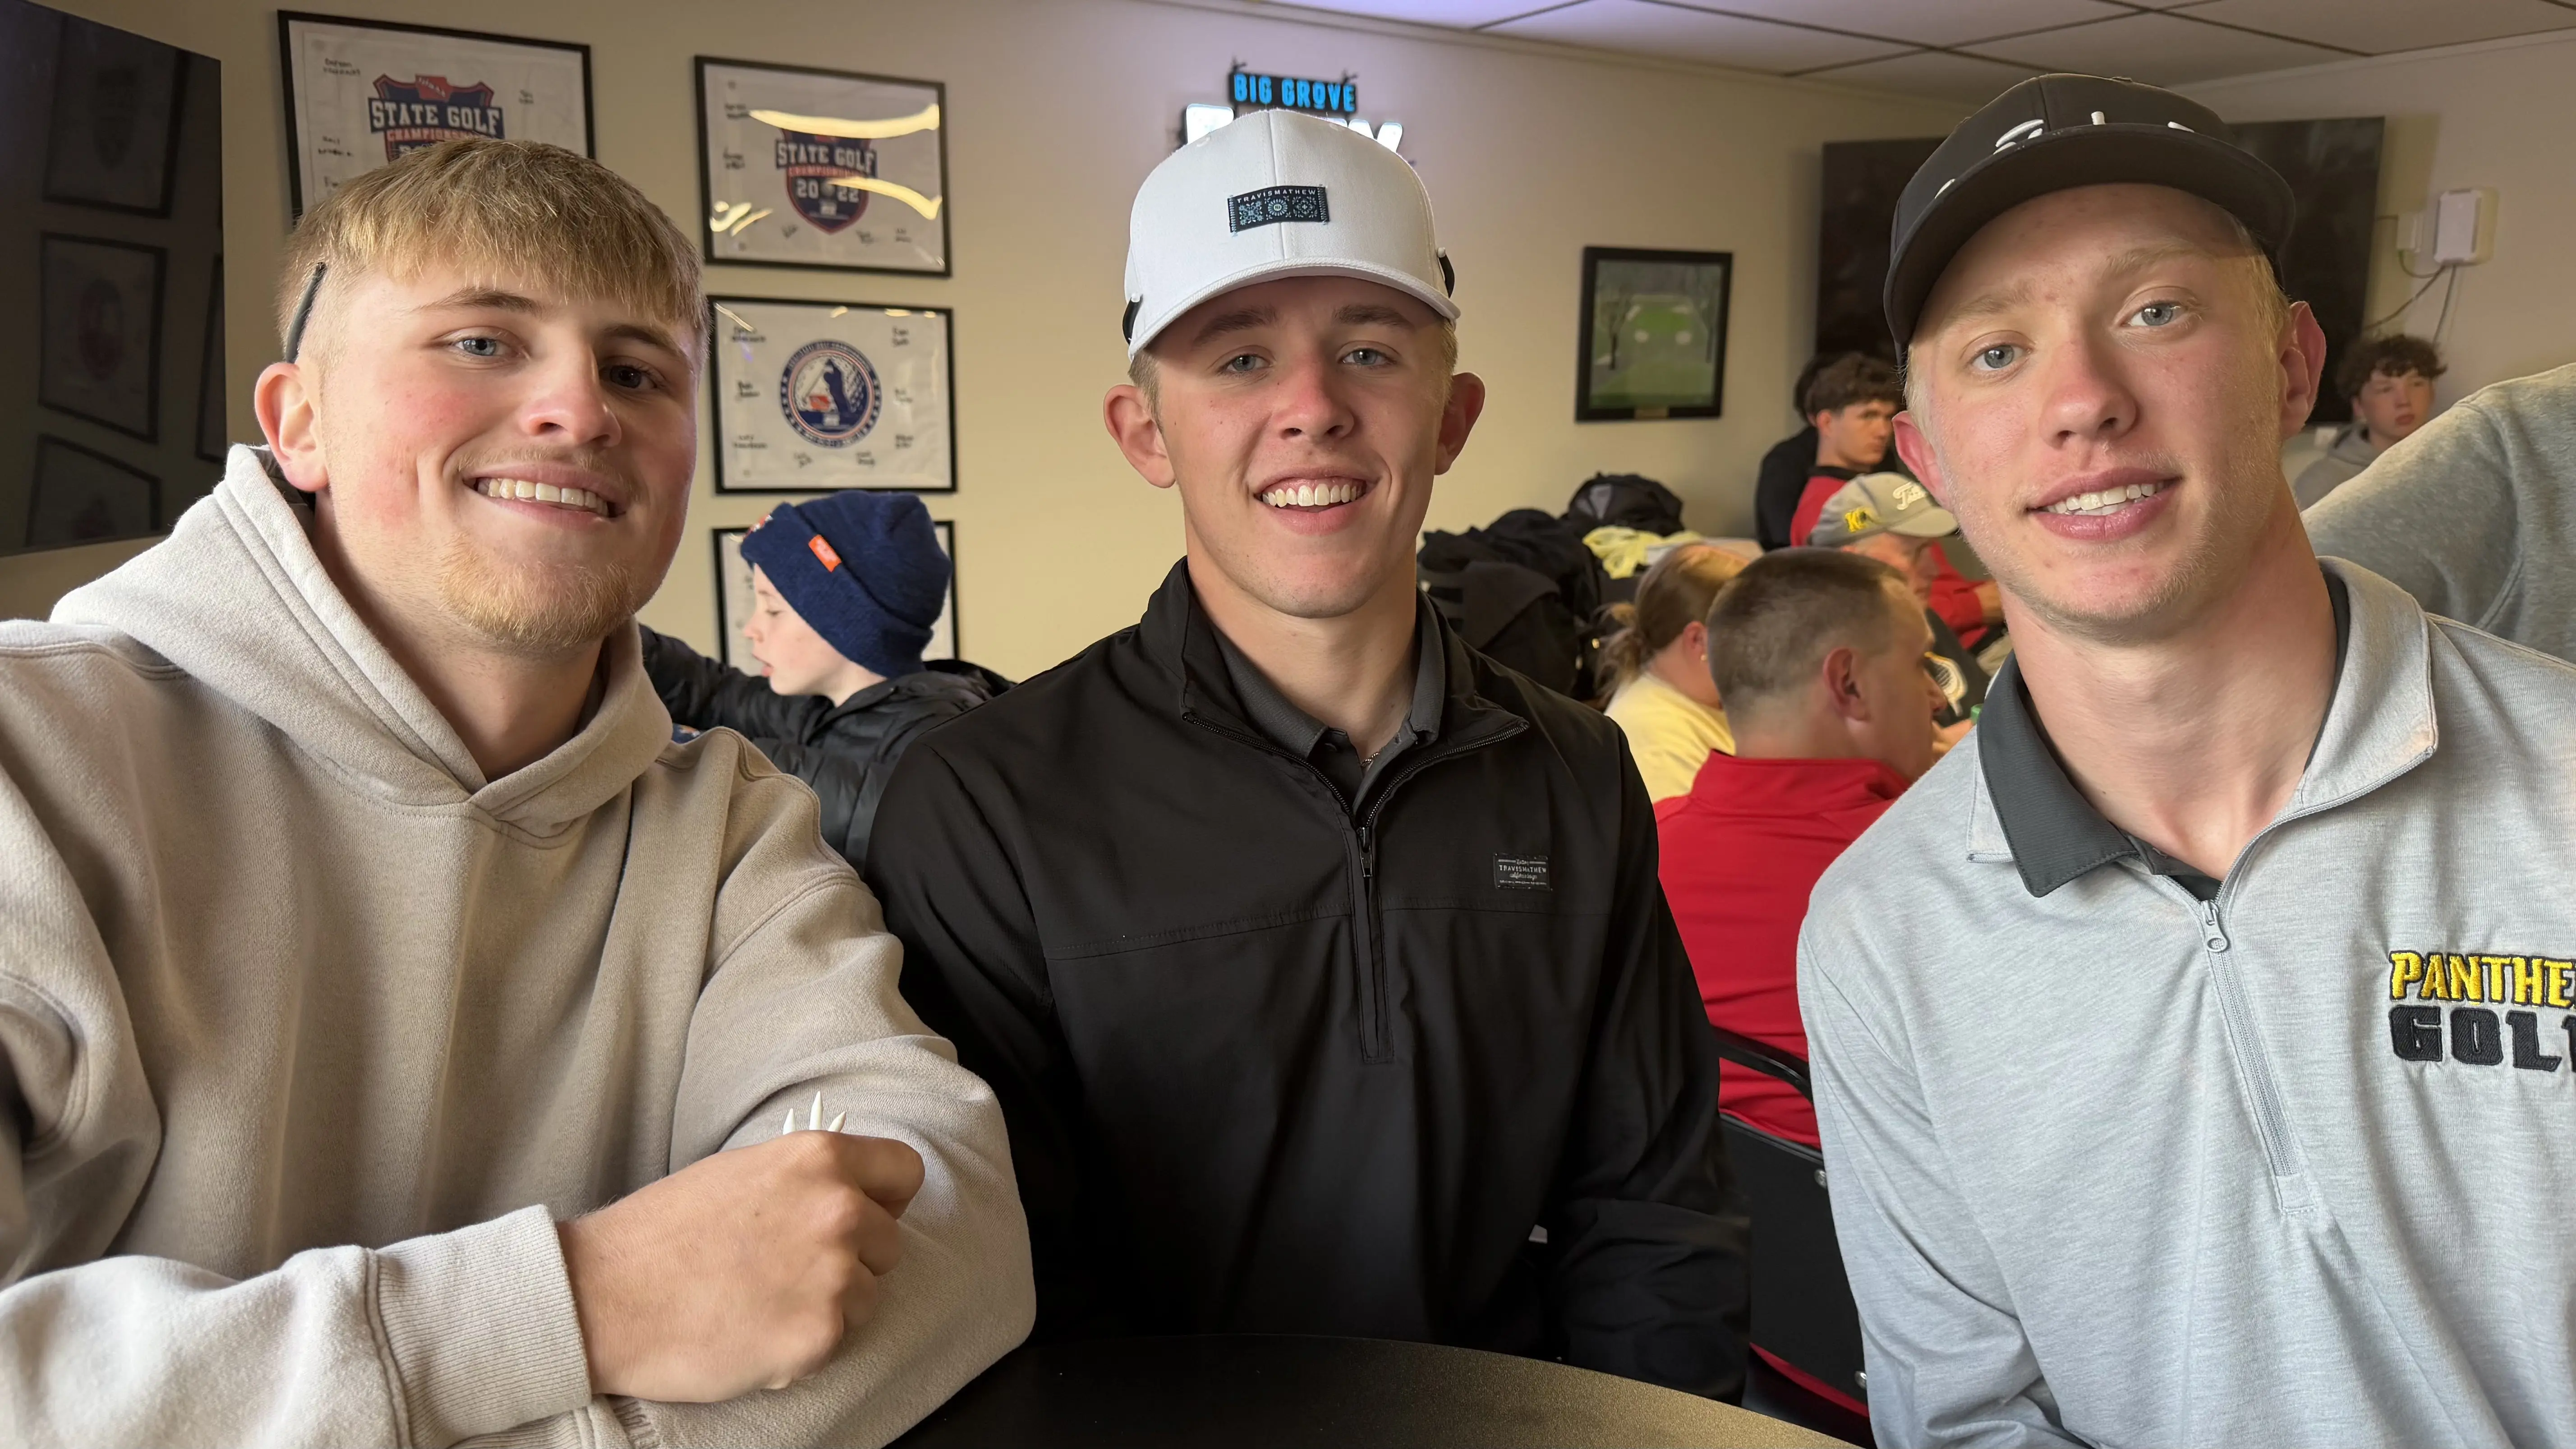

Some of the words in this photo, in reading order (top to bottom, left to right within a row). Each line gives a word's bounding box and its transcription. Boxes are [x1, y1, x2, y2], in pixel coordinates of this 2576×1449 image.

[1234, 73, 1272, 104] BIG
[1281, 78, 1355, 112] GROVE
[371, 100, 440, 129] STATE
[447, 106, 500, 136] GOLF
[777, 142, 829, 166] STATE
[835, 147, 874, 176] GOLF
[796, 178, 819, 199] 20
[1237, 189, 1316, 203] TRAVISMATHEW
[1499, 865, 1547, 874] TRAVISMATHEW
[2389, 950, 2576, 1010] PANTHE
[2388, 1004, 2576, 1073] GOL
